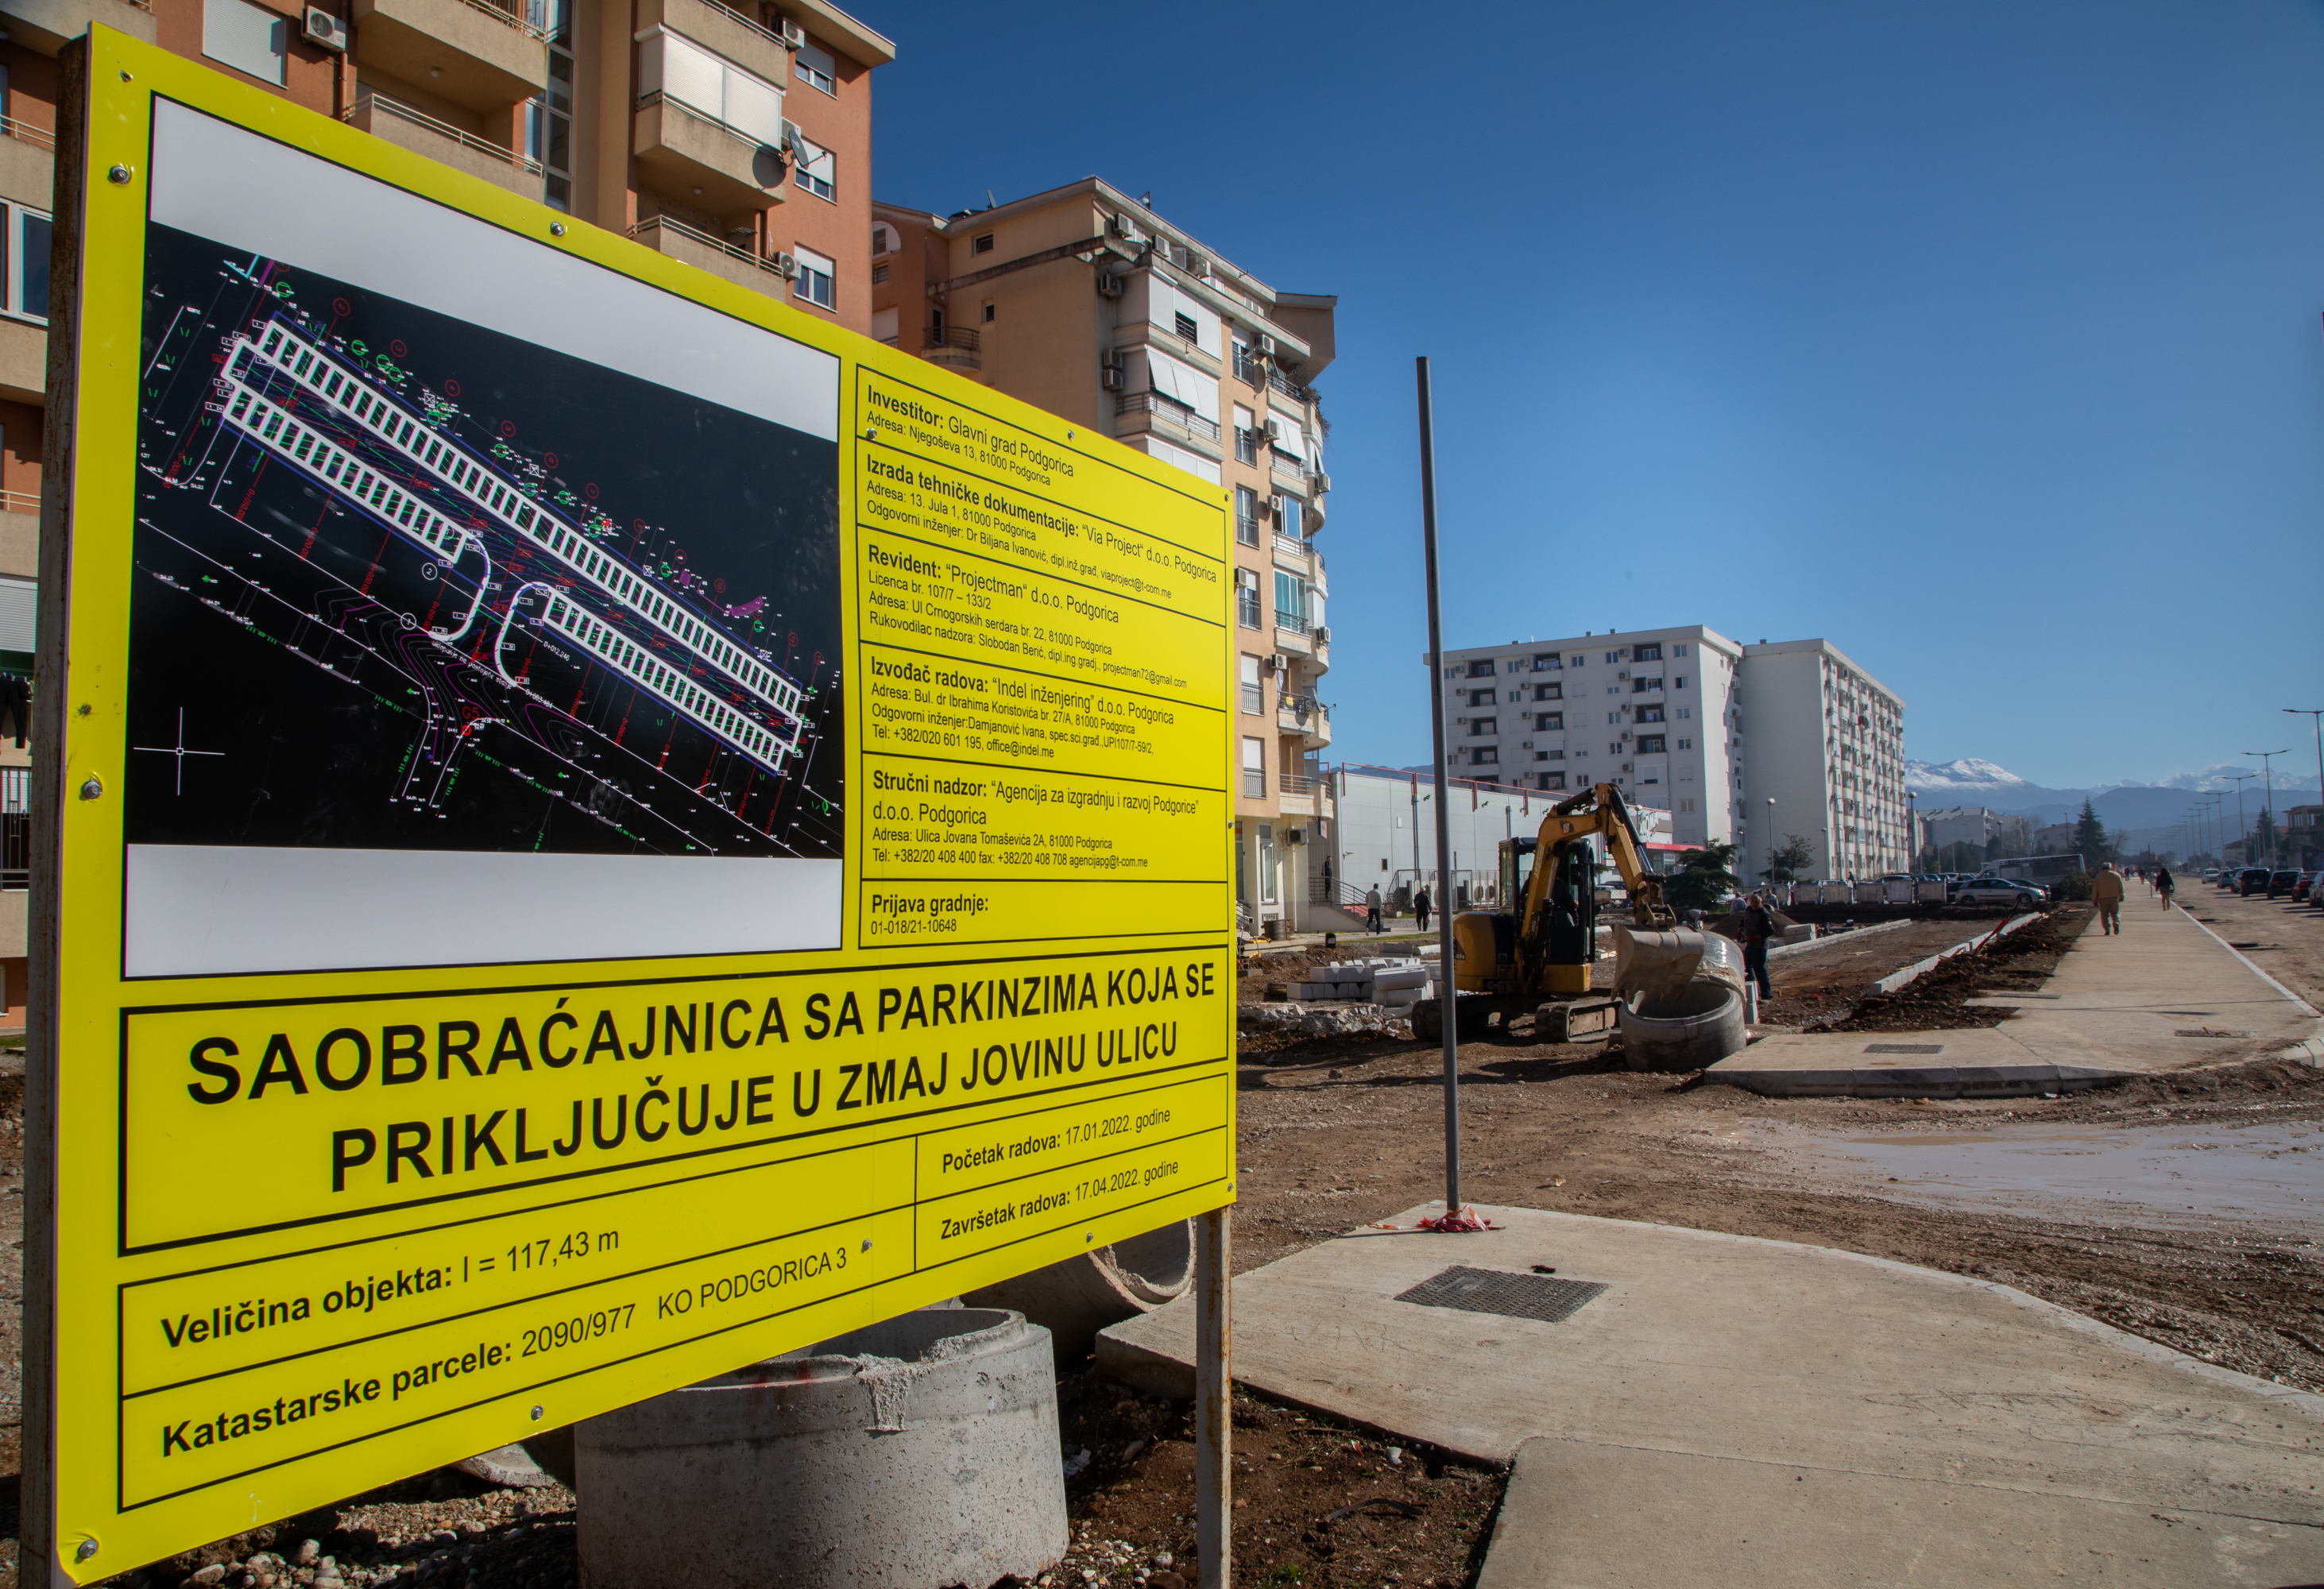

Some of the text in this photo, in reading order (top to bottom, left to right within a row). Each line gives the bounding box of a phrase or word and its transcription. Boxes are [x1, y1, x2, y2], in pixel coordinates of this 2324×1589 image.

[867, 410, 1050, 485] Adresa: Njegoševa 13, 81000 Podgorica
[868, 385, 1073, 477] Investitor: Glavni grad Podgorica
[866, 479, 1036, 541] Adresa: 13. Jula 1, 81000 Podgorica
[867, 453, 914, 485] Izrada
[918, 471, 980, 505] tehničke
[984, 493, 1079, 538] dokumentacije:
[1147, 547, 1172, 567] d.o.o.
[1174, 555, 1216, 582] Podgorica
[867, 499, 1172, 600] Odgovorni inženjer: Dr Biljana Ivanović, dipl.inž.građ, viaproject@t-com.me
[868, 543, 941, 579] Revident:
[1031, 586, 1062, 609] d.o.o.
[1066, 594, 1119, 623] Podgorica
[868, 569, 908, 591] Licenca
[911, 579, 924, 594] br.
[927, 583, 954, 601] 107/7
[966, 593, 991, 610] 133/2
[869, 590, 1112, 655] Adresa: Ul Crnogorskih serdara br. 22, 81000 Podgorica
[870, 610, 1188, 689] Rukovodilac nadzora: Slobodan Berić, dipl.ing.gradj., projectman72@gmail.com
[462, 706, 480, 720] G5
[871, 682, 1135, 734] Adresa: Bul. dr Ibrahima Koristovića br. 27/A, 81000 Podgorica
[872, 655, 930, 683] Izvođač
[935, 670, 988, 693] radova:
[1097, 697, 1125, 716] d.o.o.
[1128, 702, 1174, 725] Podgorica
[872, 702, 925, 723] Odgovorni
[928, 710, 1020, 735] inženjer:Damjanović
[1023, 724, 1047, 740] Ivana,
[872, 723, 1054, 758] Tel: +382/020 601 195, office@indel.me
[872, 800, 986, 828] d.o.o. Podgorica
[873, 769, 929, 793] Stručni
[934, 777, 987, 797] nadzor:
[1050, 790, 1064, 803] za
[1068, 787, 1114, 810] izgradnju
[1117, 792, 1119, 807] i
[1123, 795, 1150, 814] razvoj
[872, 826, 1112, 852] Adresa: Ulica Jovana Tomaševića 2A, 81000 Podgorica
[872, 848, 1148, 869] Tel: +382/20 408 400 fax: +382/20 408 708 agencijapg@t-com.me
[871, 918, 957, 935] 01-018/21-10648
[872, 894, 988, 918] Prijava gradnje:
[188, 962, 1214, 1105] SAOBRAĆAJNICA SA PARKINZIMA KOJA SE
[332, 1021, 1177, 1193] PRIKLJUČUJE U ZMAJ JOVINU ULICU
[943, 1108, 1170, 1173] Početak radova: 17.01.2022. godine
[941, 1161, 1178, 1240] Završetak radova: 17.04.2022. godine
[160, 1297, 310, 1348] Veličina
[323, 1266, 450, 1313] objekta:
[479, 1257, 495, 1272] =
[507, 1231, 589, 1272] 117,43
[598, 1231, 618, 1252] m
[164, 1247, 846, 1458] Katastarske parcele: 2090/977 KO PODGORICA 3
